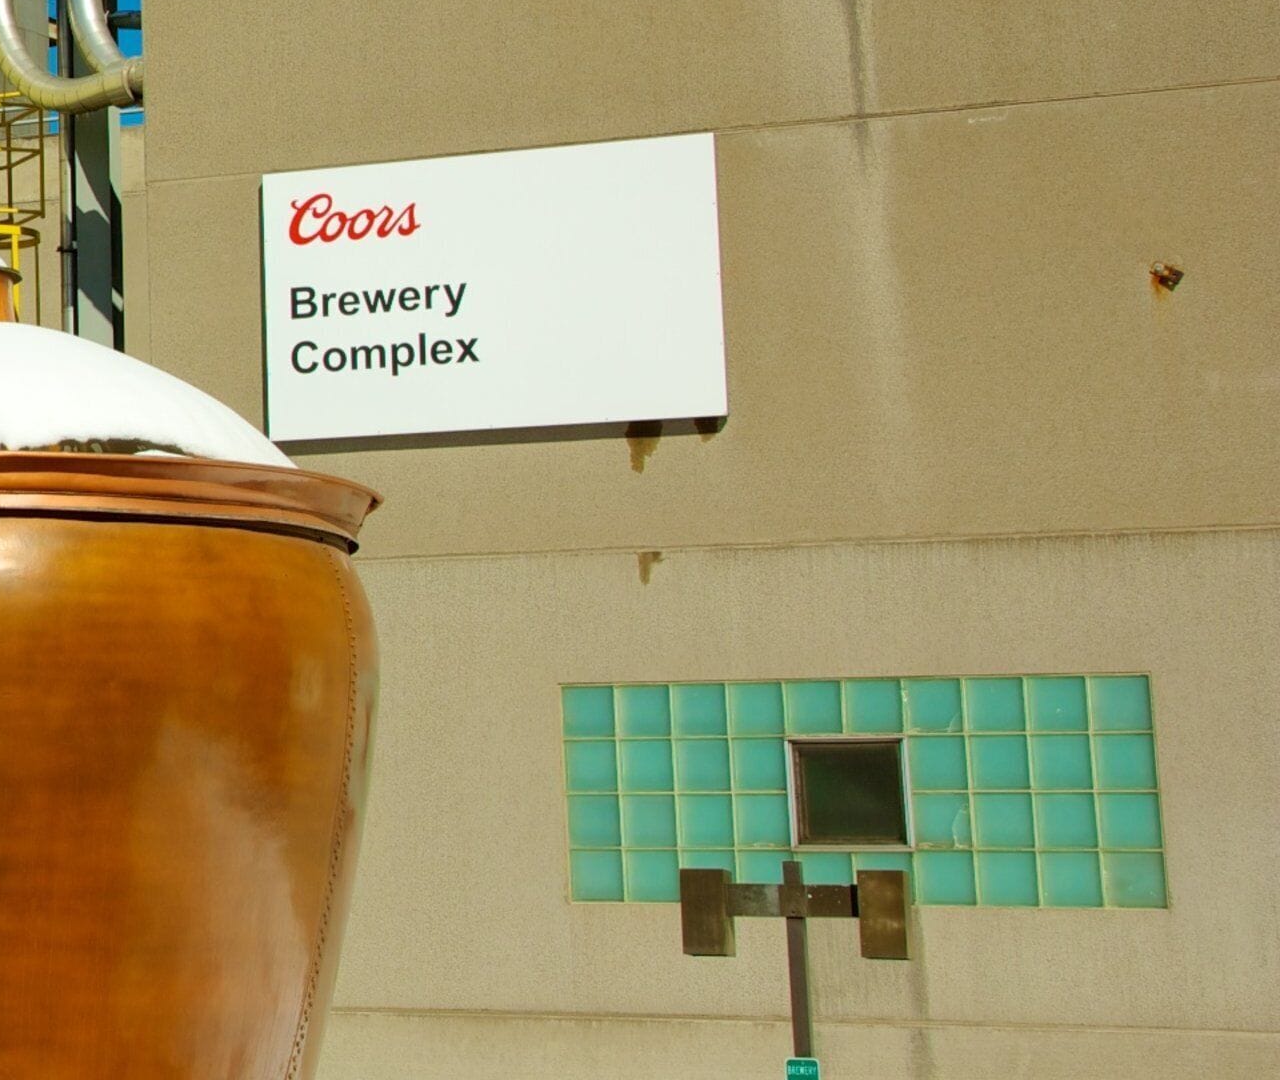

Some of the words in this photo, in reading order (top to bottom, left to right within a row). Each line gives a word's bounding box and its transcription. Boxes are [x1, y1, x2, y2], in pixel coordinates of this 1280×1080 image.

[288, 193, 421, 246] Coors
[290, 282, 467, 320] Brewery
[291, 333, 480, 376] Complex
